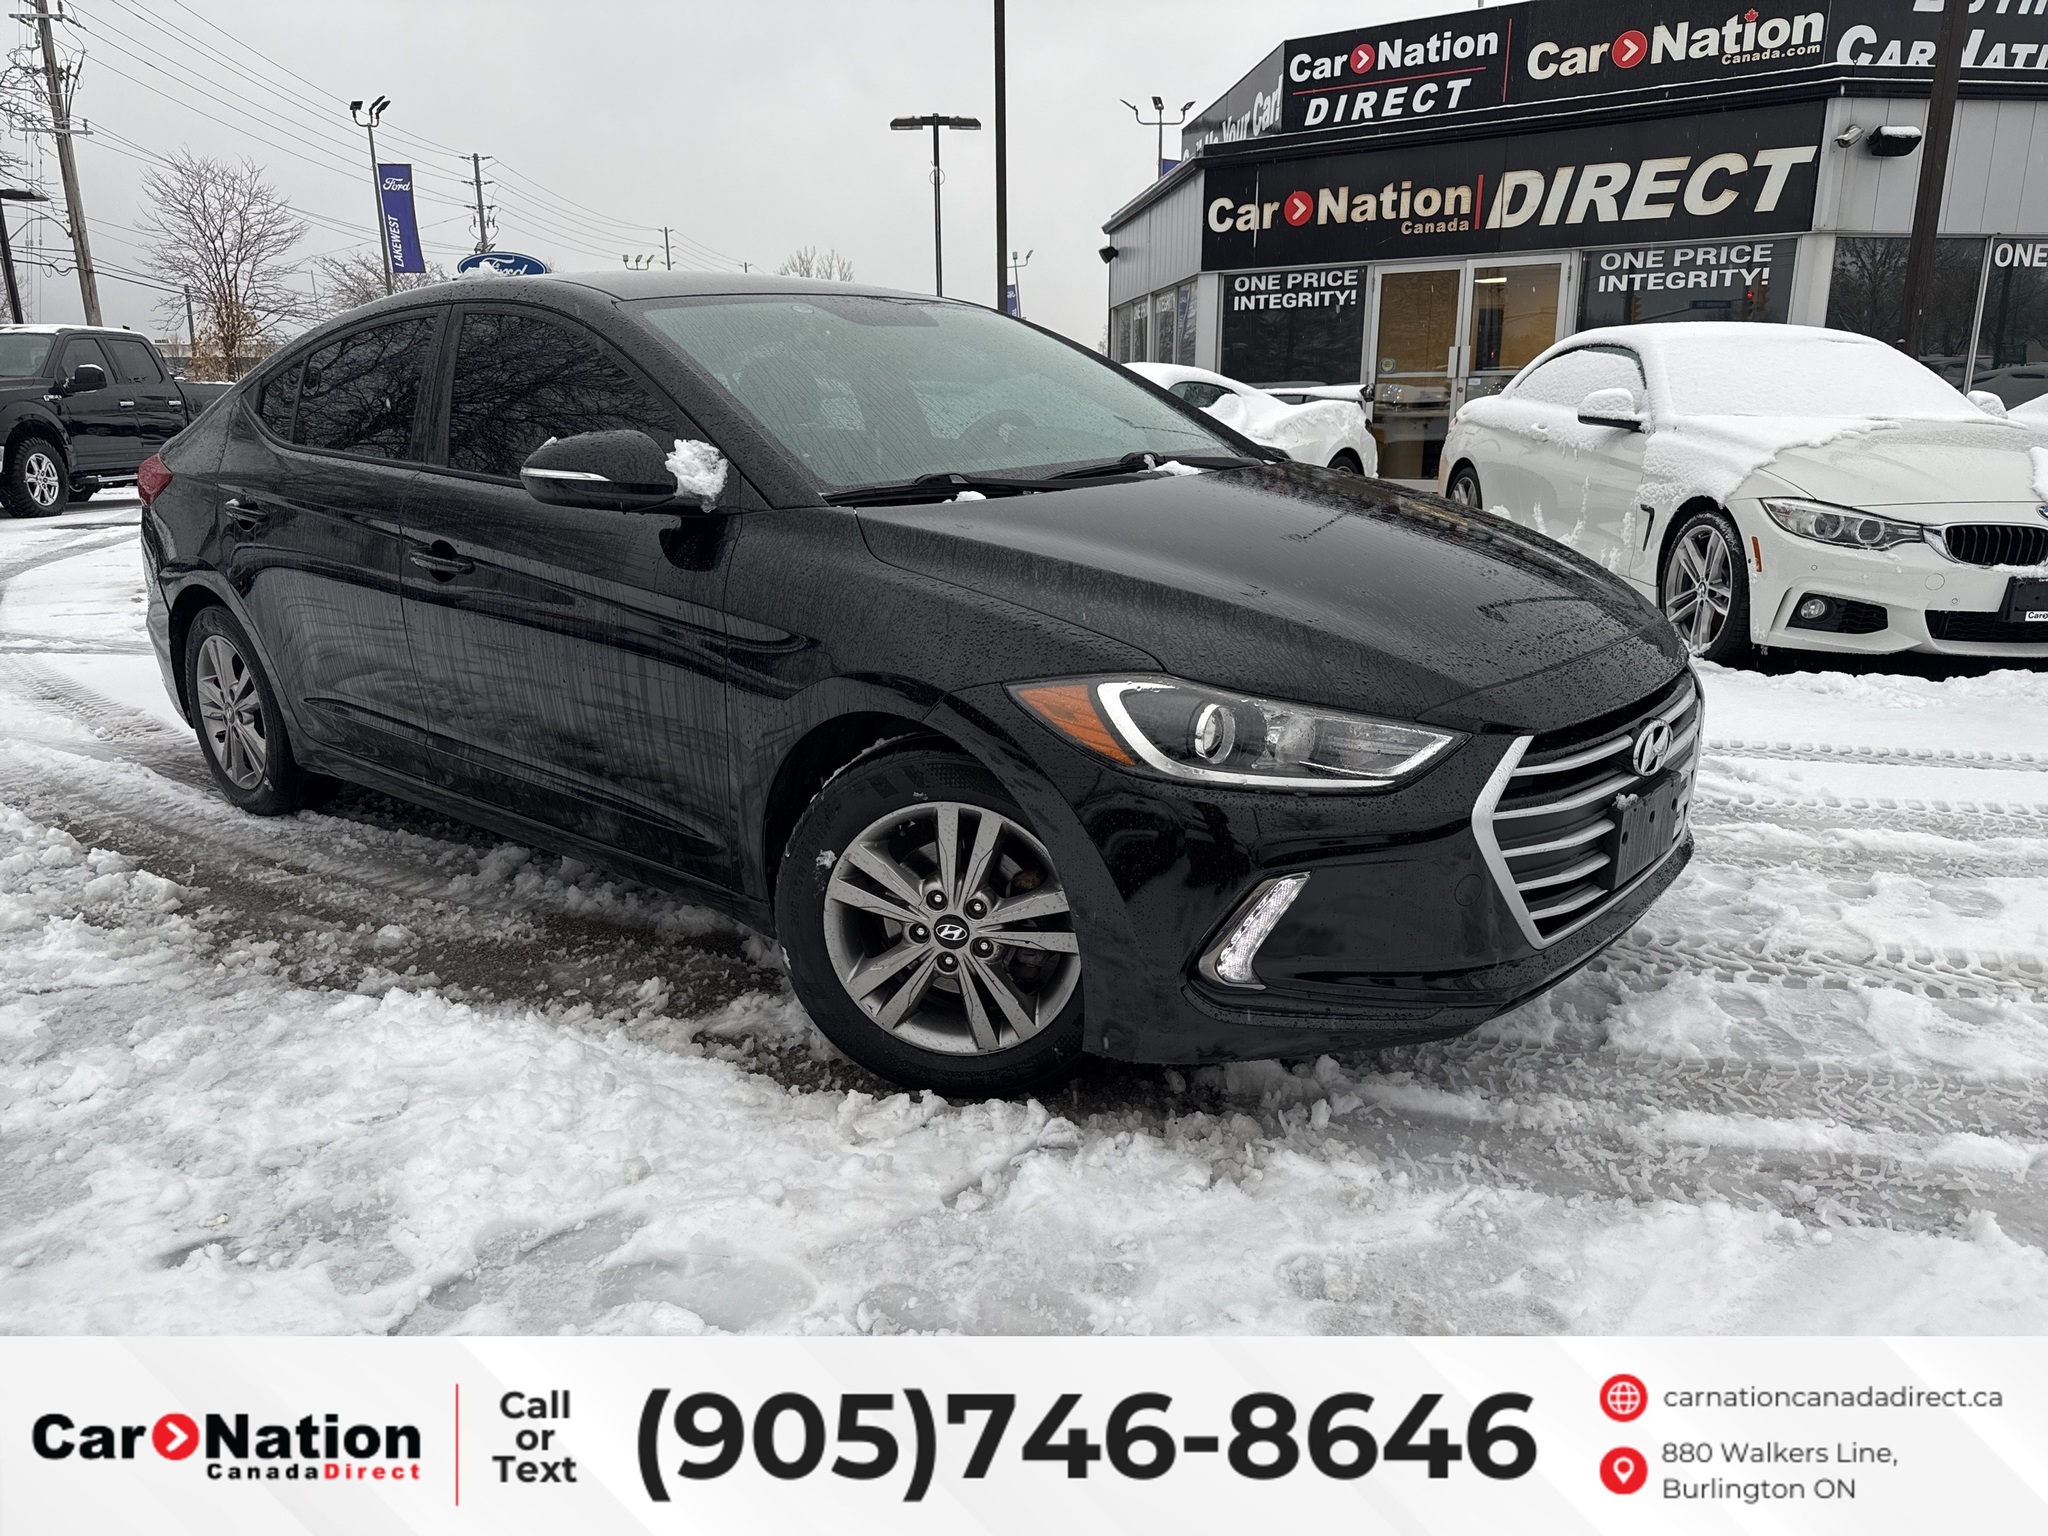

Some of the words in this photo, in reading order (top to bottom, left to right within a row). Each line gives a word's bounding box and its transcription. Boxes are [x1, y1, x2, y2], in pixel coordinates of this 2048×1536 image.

[1289, 53, 1348, 83] Car
[1377, 31, 1498, 71] Nation
[1527, 42, 1610, 80] Car
[1650, 11, 1825, 64] Nation
[1721, 43, 1821, 66] Canada.com
[1836, 24, 1936, 66] CAR
[1304, 78, 1472, 126] DIRECT
[383, 177, 411, 191] Ford
[1208, 197, 1280, 233] Car
[1317, 180, 1472, 225] Nation
[1485, 145, 1818, 229] DIRECT
[1401, 218, 1469, 235] Canada
[388, 214, 404, 268] LAKEWEST
[1600, 250, 1666, 271] ONE
[1673, 243, 1774, 267] PRICE
[1994, 243, 2048, 268] ONE
[1234, 273, 1281, 292] ONE
[1287, 269, 1358, 288] PRICE
[1598, 267, 1770, 293] INTEGRITY!
[1233, 289, 1357, 311] INTEGRITY!
